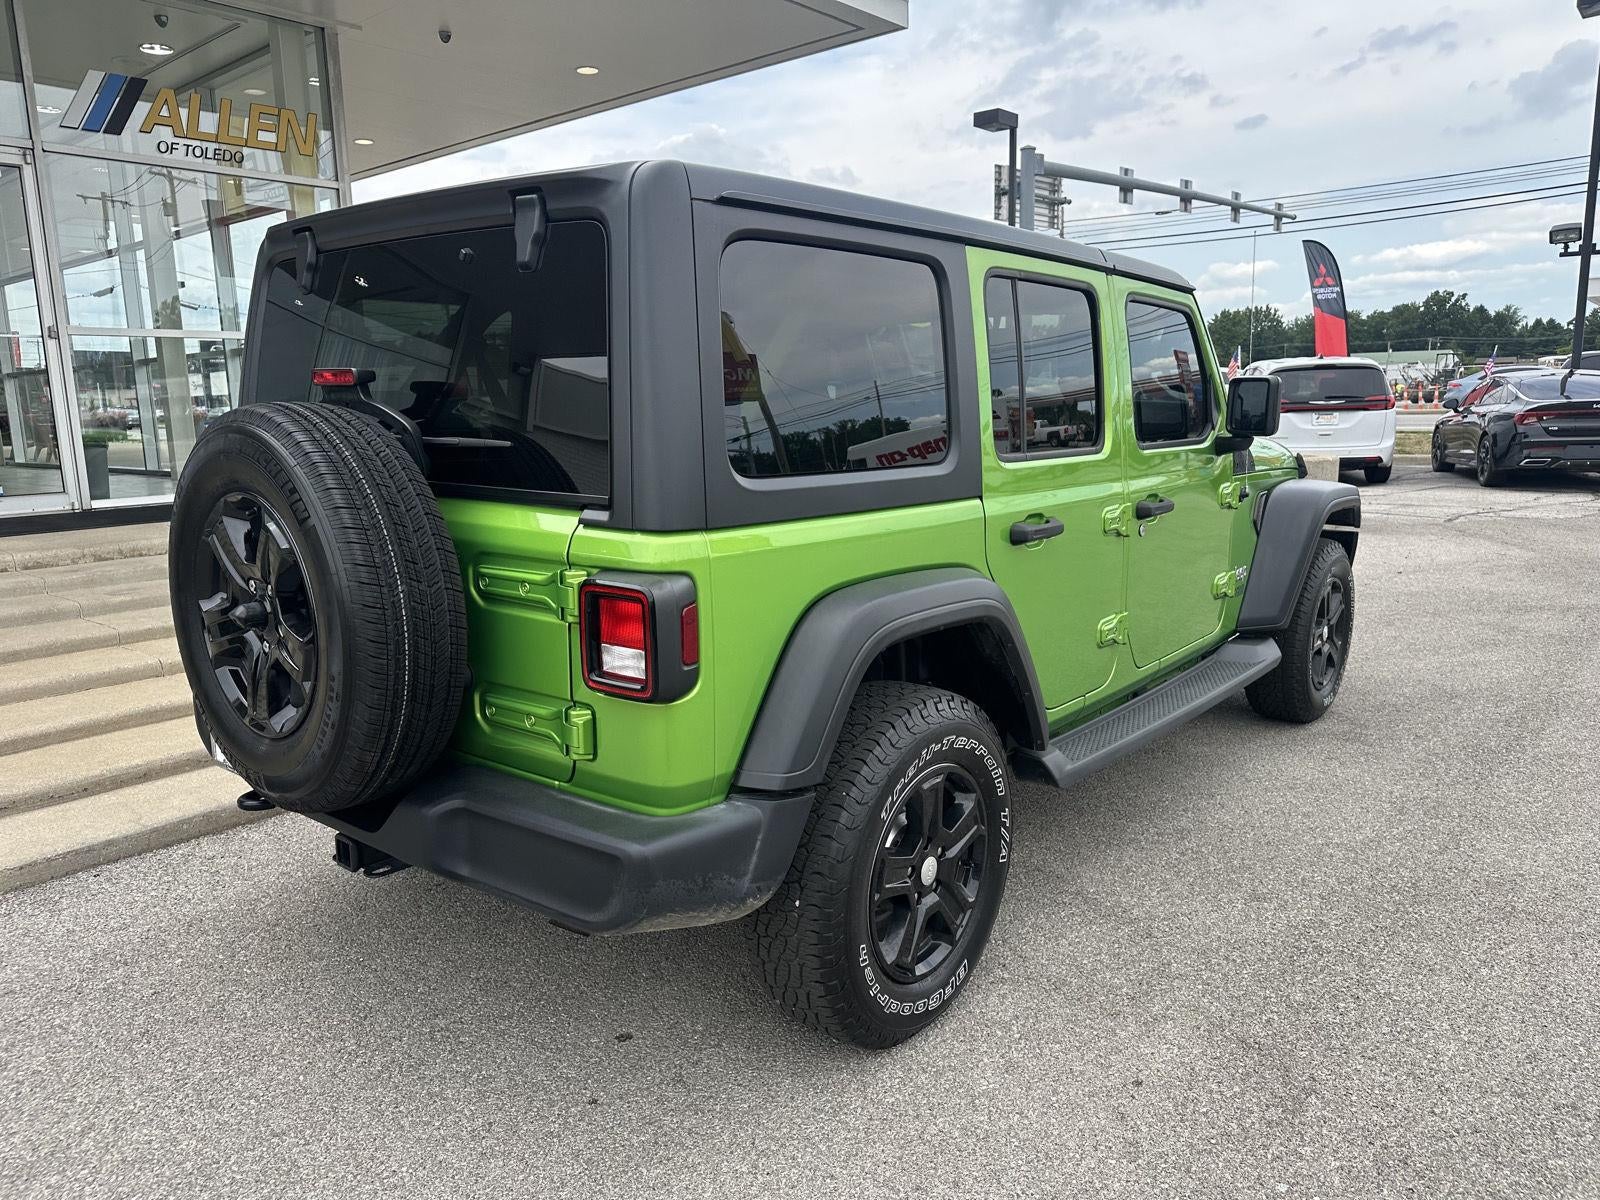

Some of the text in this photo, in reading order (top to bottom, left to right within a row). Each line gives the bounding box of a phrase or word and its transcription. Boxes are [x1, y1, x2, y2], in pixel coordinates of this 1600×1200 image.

[140, 87, 318, 157] ALLEN
[157, 140, 245, 164] OF TOLEDO
[859, 944, 969, 1015] BFGoodrich
